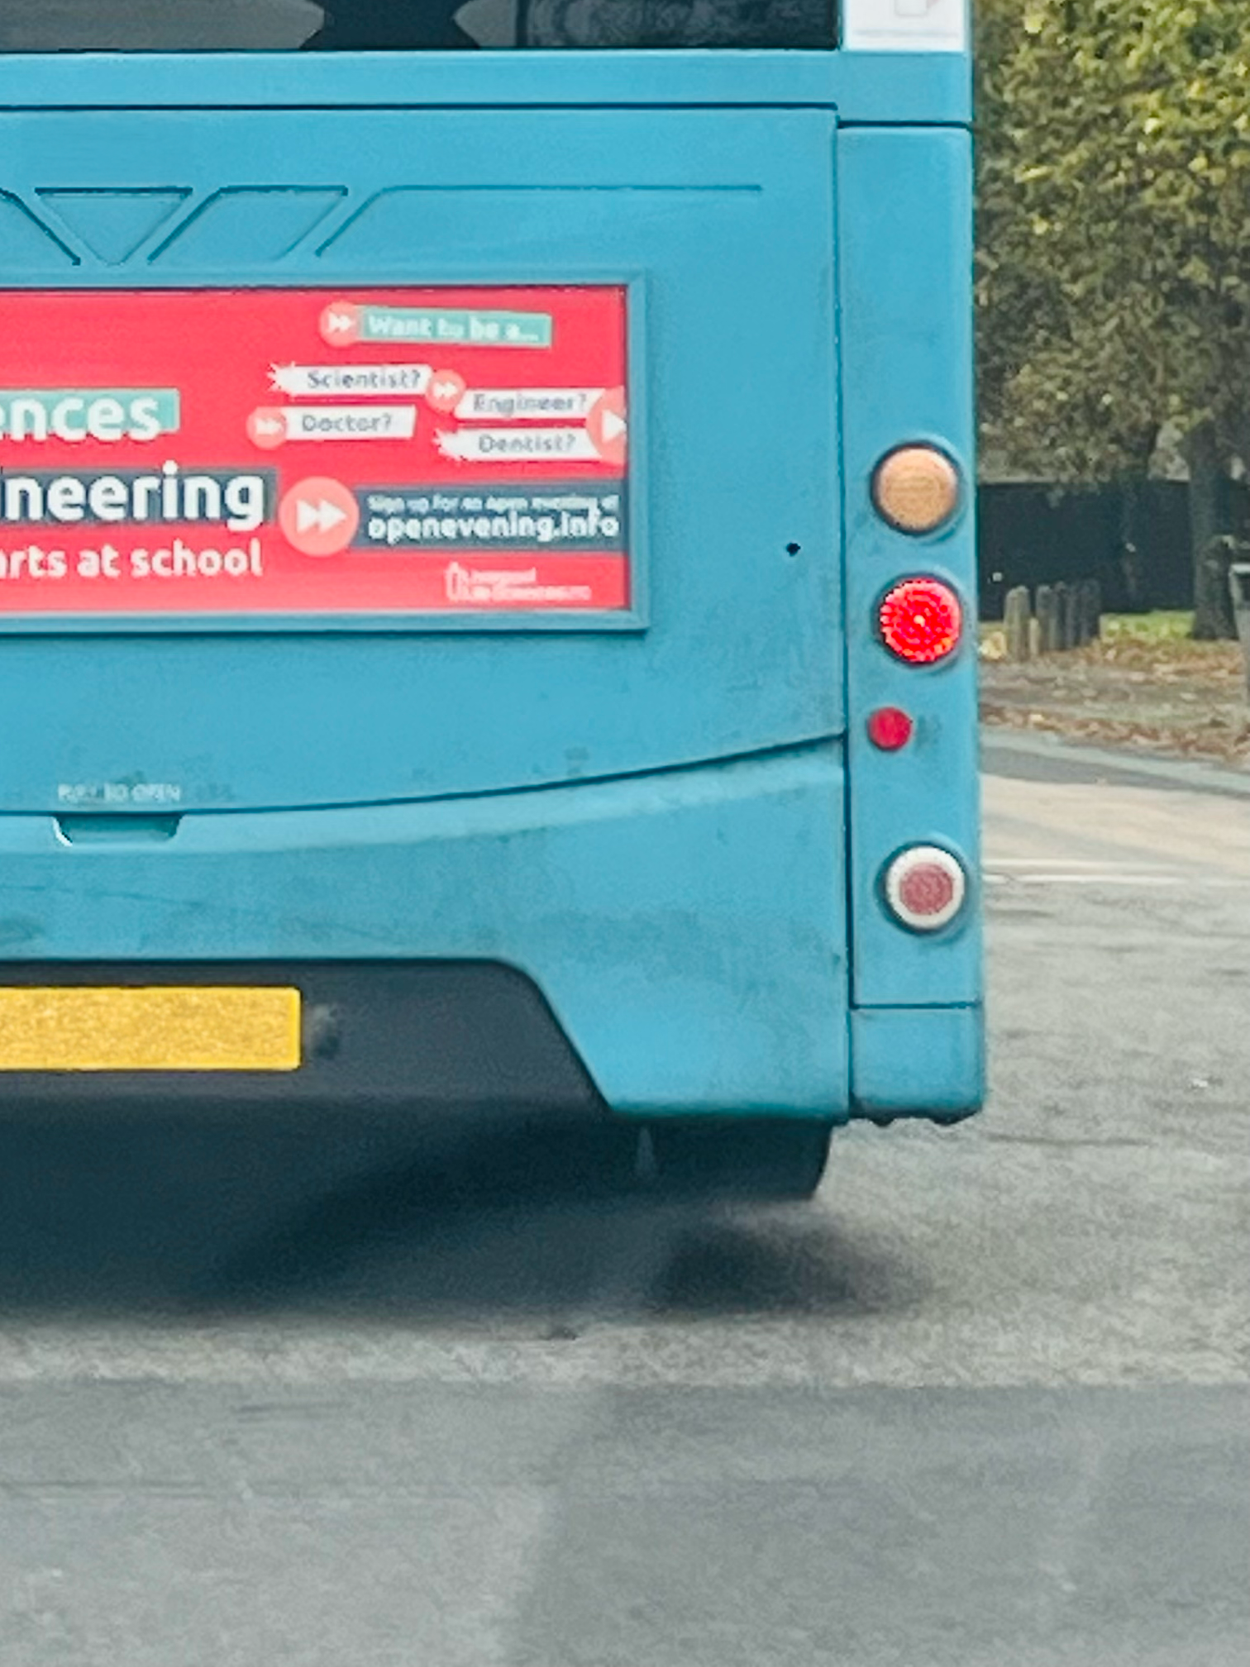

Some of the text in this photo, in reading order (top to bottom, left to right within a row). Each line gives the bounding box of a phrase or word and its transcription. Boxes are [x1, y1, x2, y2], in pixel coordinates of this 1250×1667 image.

[368, 315, 431, 335] Want
[470, 316, 499, 336] be
[307, 369, 422, 389] Scientist?
[473, 393, 588, 417] Engineer?
[301, 412, 393, 433] Doctor?
[478, 434, 577, 454] Dentist?
[368, 507, 620, 546] openevening.info
[77, 547, 119, 579] at
[130, 537, 263, 578] school
